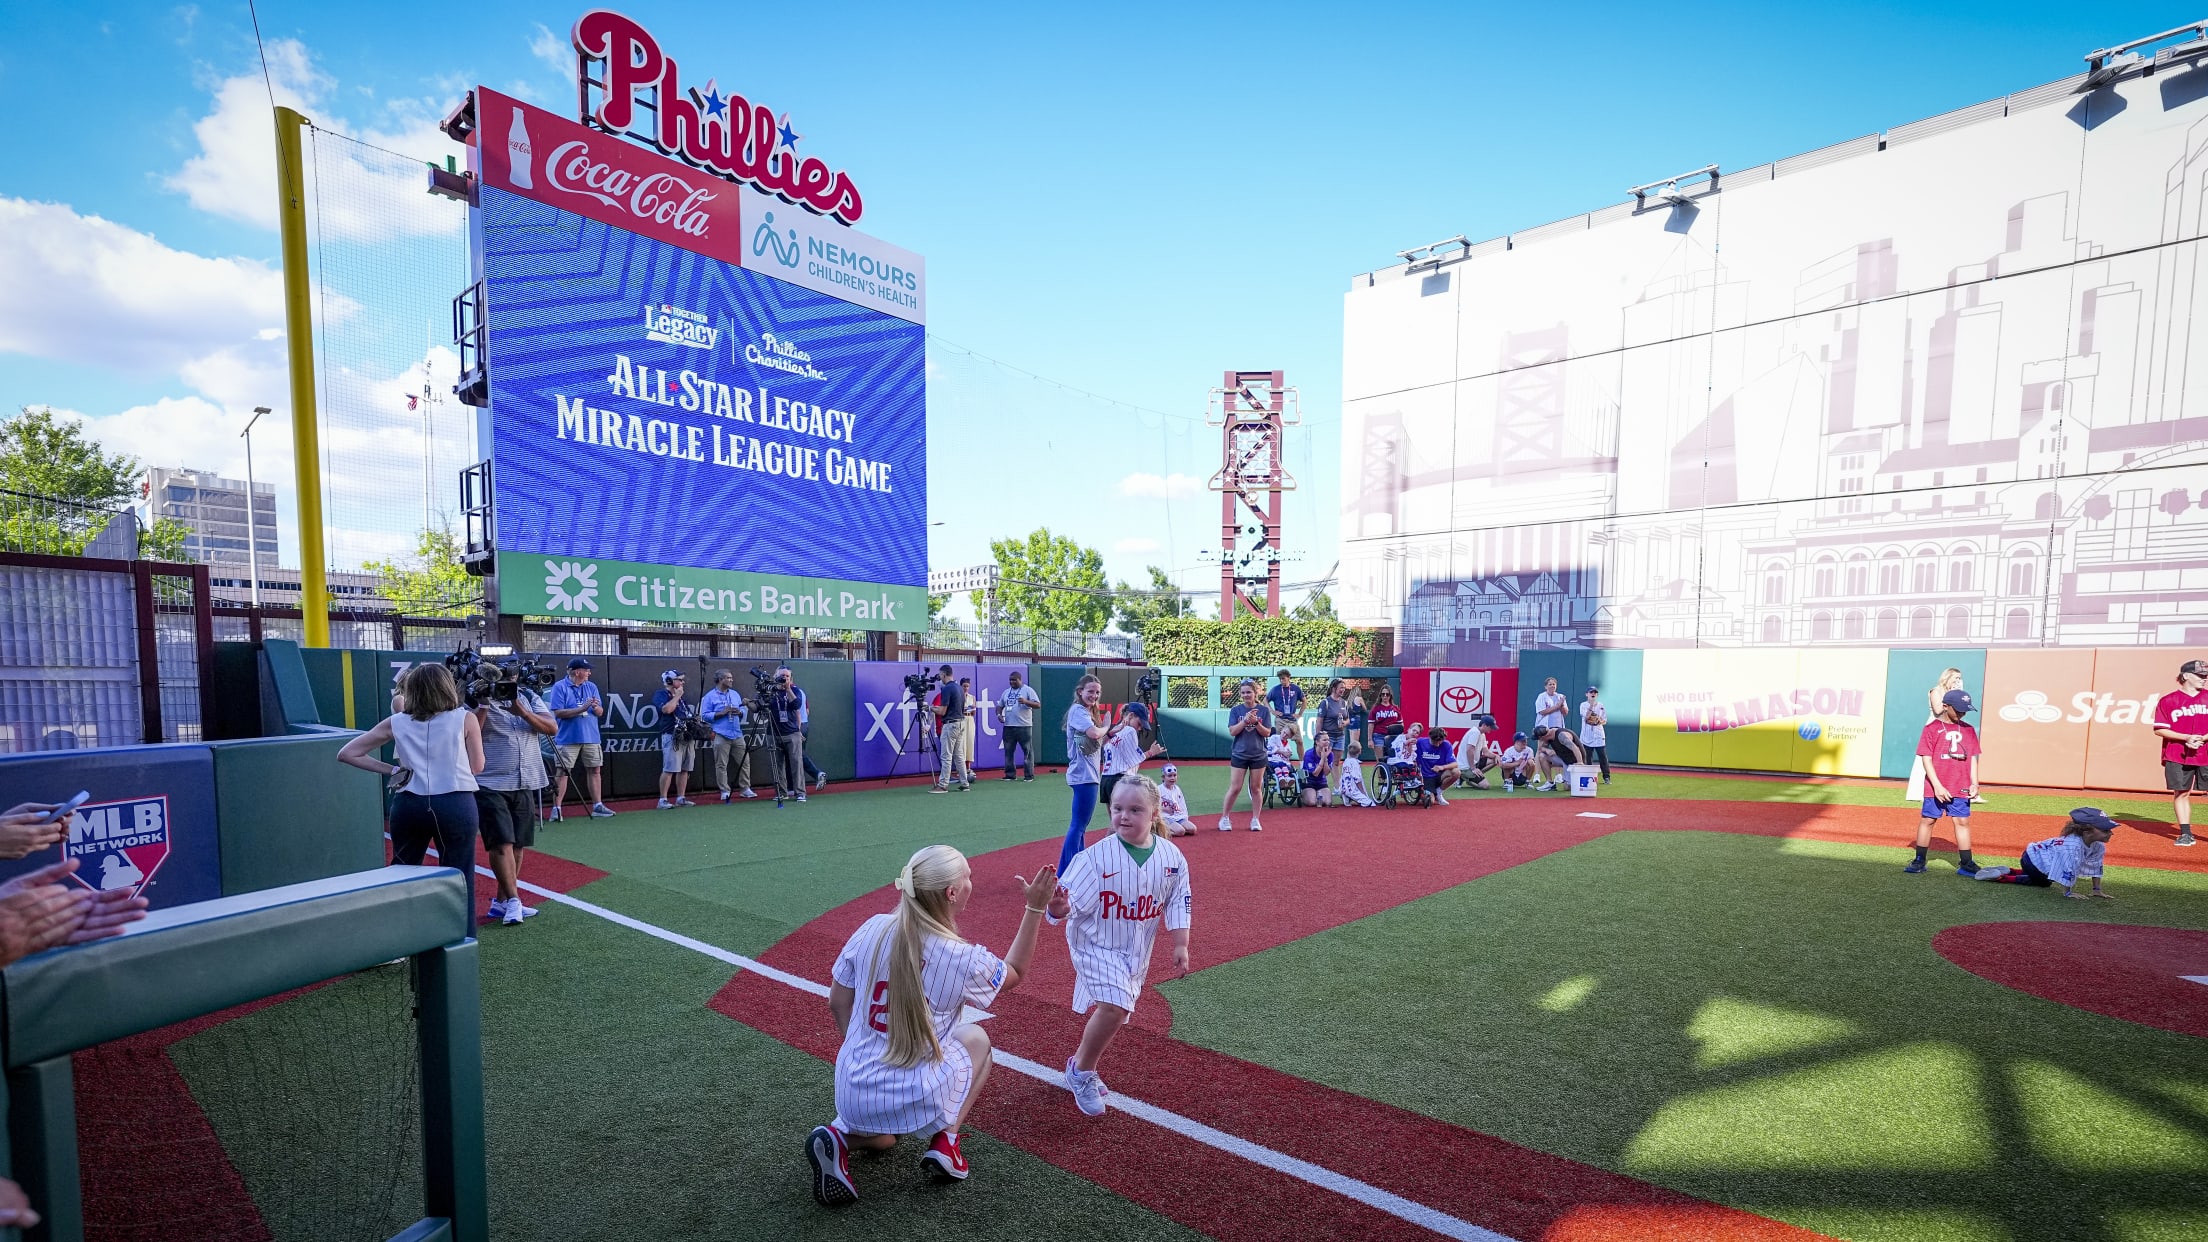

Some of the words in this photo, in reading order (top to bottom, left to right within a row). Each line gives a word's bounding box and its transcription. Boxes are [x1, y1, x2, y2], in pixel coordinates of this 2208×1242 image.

[572, 10, 864, 223] Phillies
[545, 141, 718, 237] Coca-Cola
[808, 236, 917, 291] NEMOURS
[808, 261, 875, 296] CHILDREN'S
[878, 284, 917, 310] HEALTH
[644, 304, 719, 345] Legacy
[762, 332, 811, 362] Phillies
[758, 387, 856, 443] LEGACY
[554, 393, 705, 462] MIRACLE
[711, 424, 819, 481] LEAGUE
[825, 447, 892, 494] GAME
[614, 575, 752, 612] Citizens
[761, 585, 833, 617] Bank
[839, 591, 897, 621] Park
[1657, 693, 1685, 704] WHO
[1689, 691, 1716, 702] BUT
[1828, 725, 1867, 734] Preferred
[1945, 731, 1963, 753] P
[69, 802, 163, 844] MLB
[70, 832, 163, 856] NETWORK
